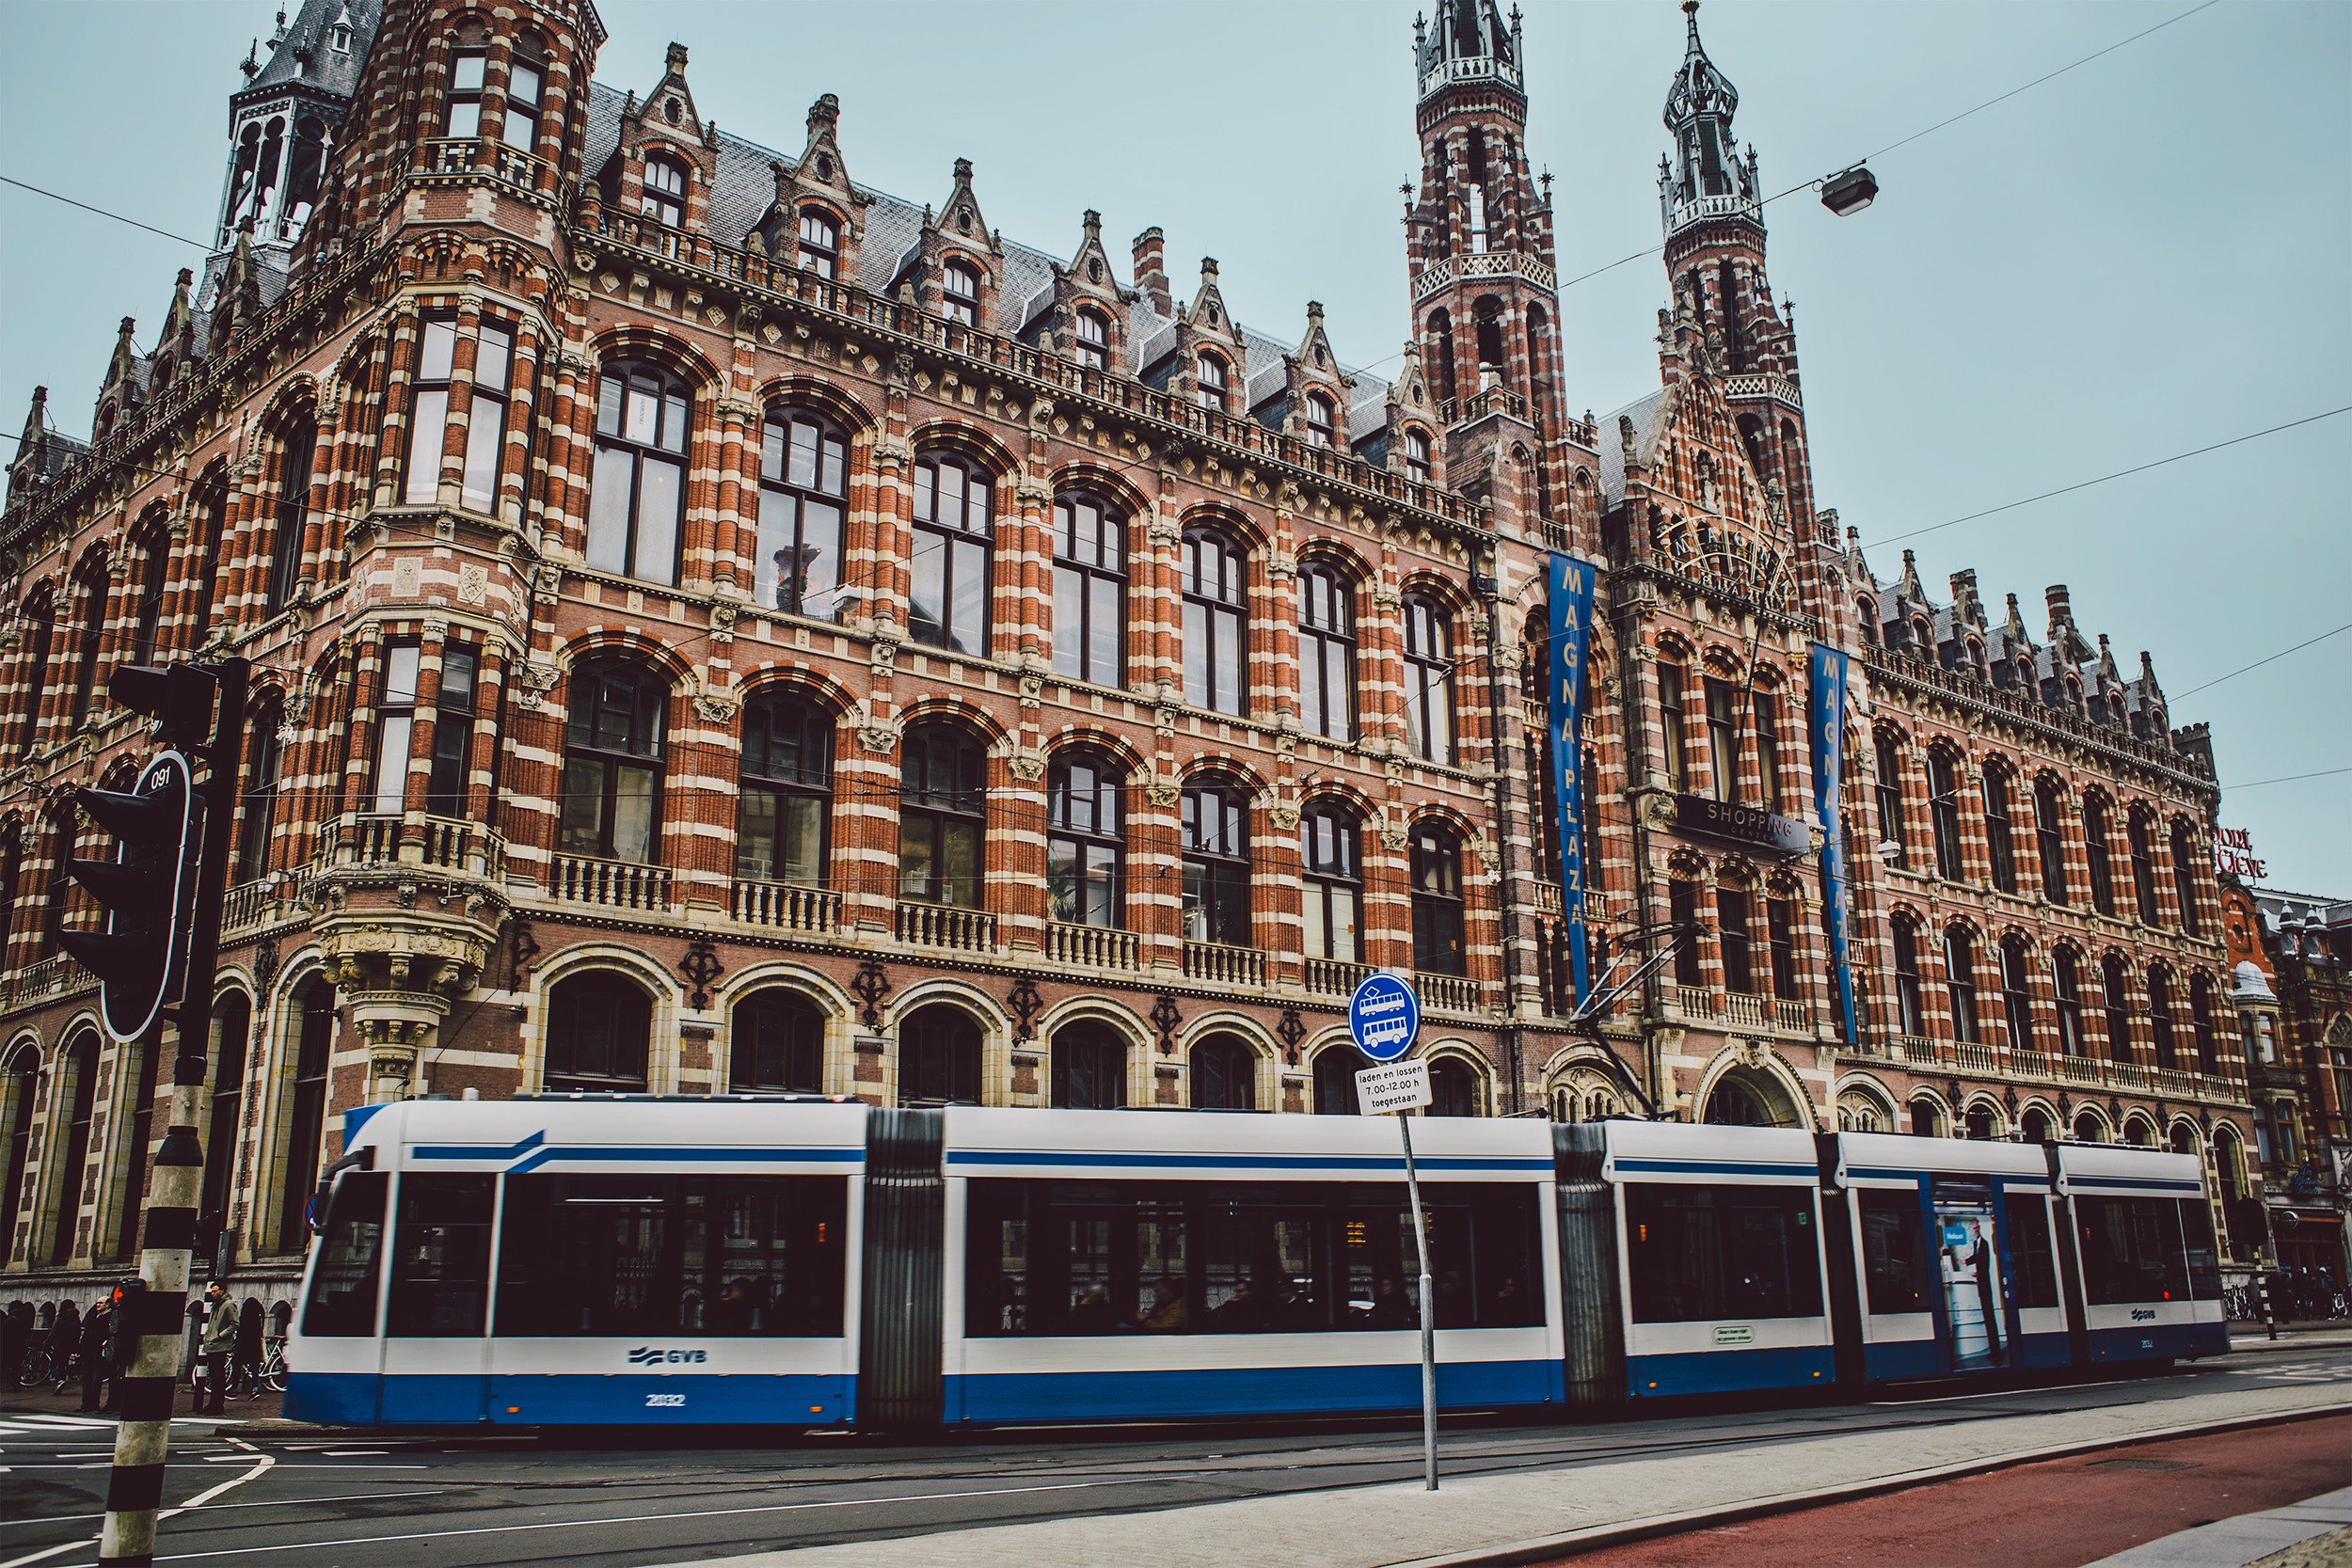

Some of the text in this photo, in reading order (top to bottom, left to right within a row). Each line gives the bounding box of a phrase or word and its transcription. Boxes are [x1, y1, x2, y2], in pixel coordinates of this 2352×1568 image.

[1562, 566, 1583, 926] MAGNA PLAZA
[151, 765, 170, 790] 091
[1708, 803, 1792, 838] SHOPPING
[1823, 656, 1850, 969] MAGNA PLAZA
[1731, 826, 1774, 843] CENTER
[1359, 1066, 1422, 1084] laden en lossen
[1366, 1079, 1420, 1096] 7.00-12.00 h
[1372, 1094, 1417, 1108] toegestaan
[666, 1349, 707, 1364] GVB
